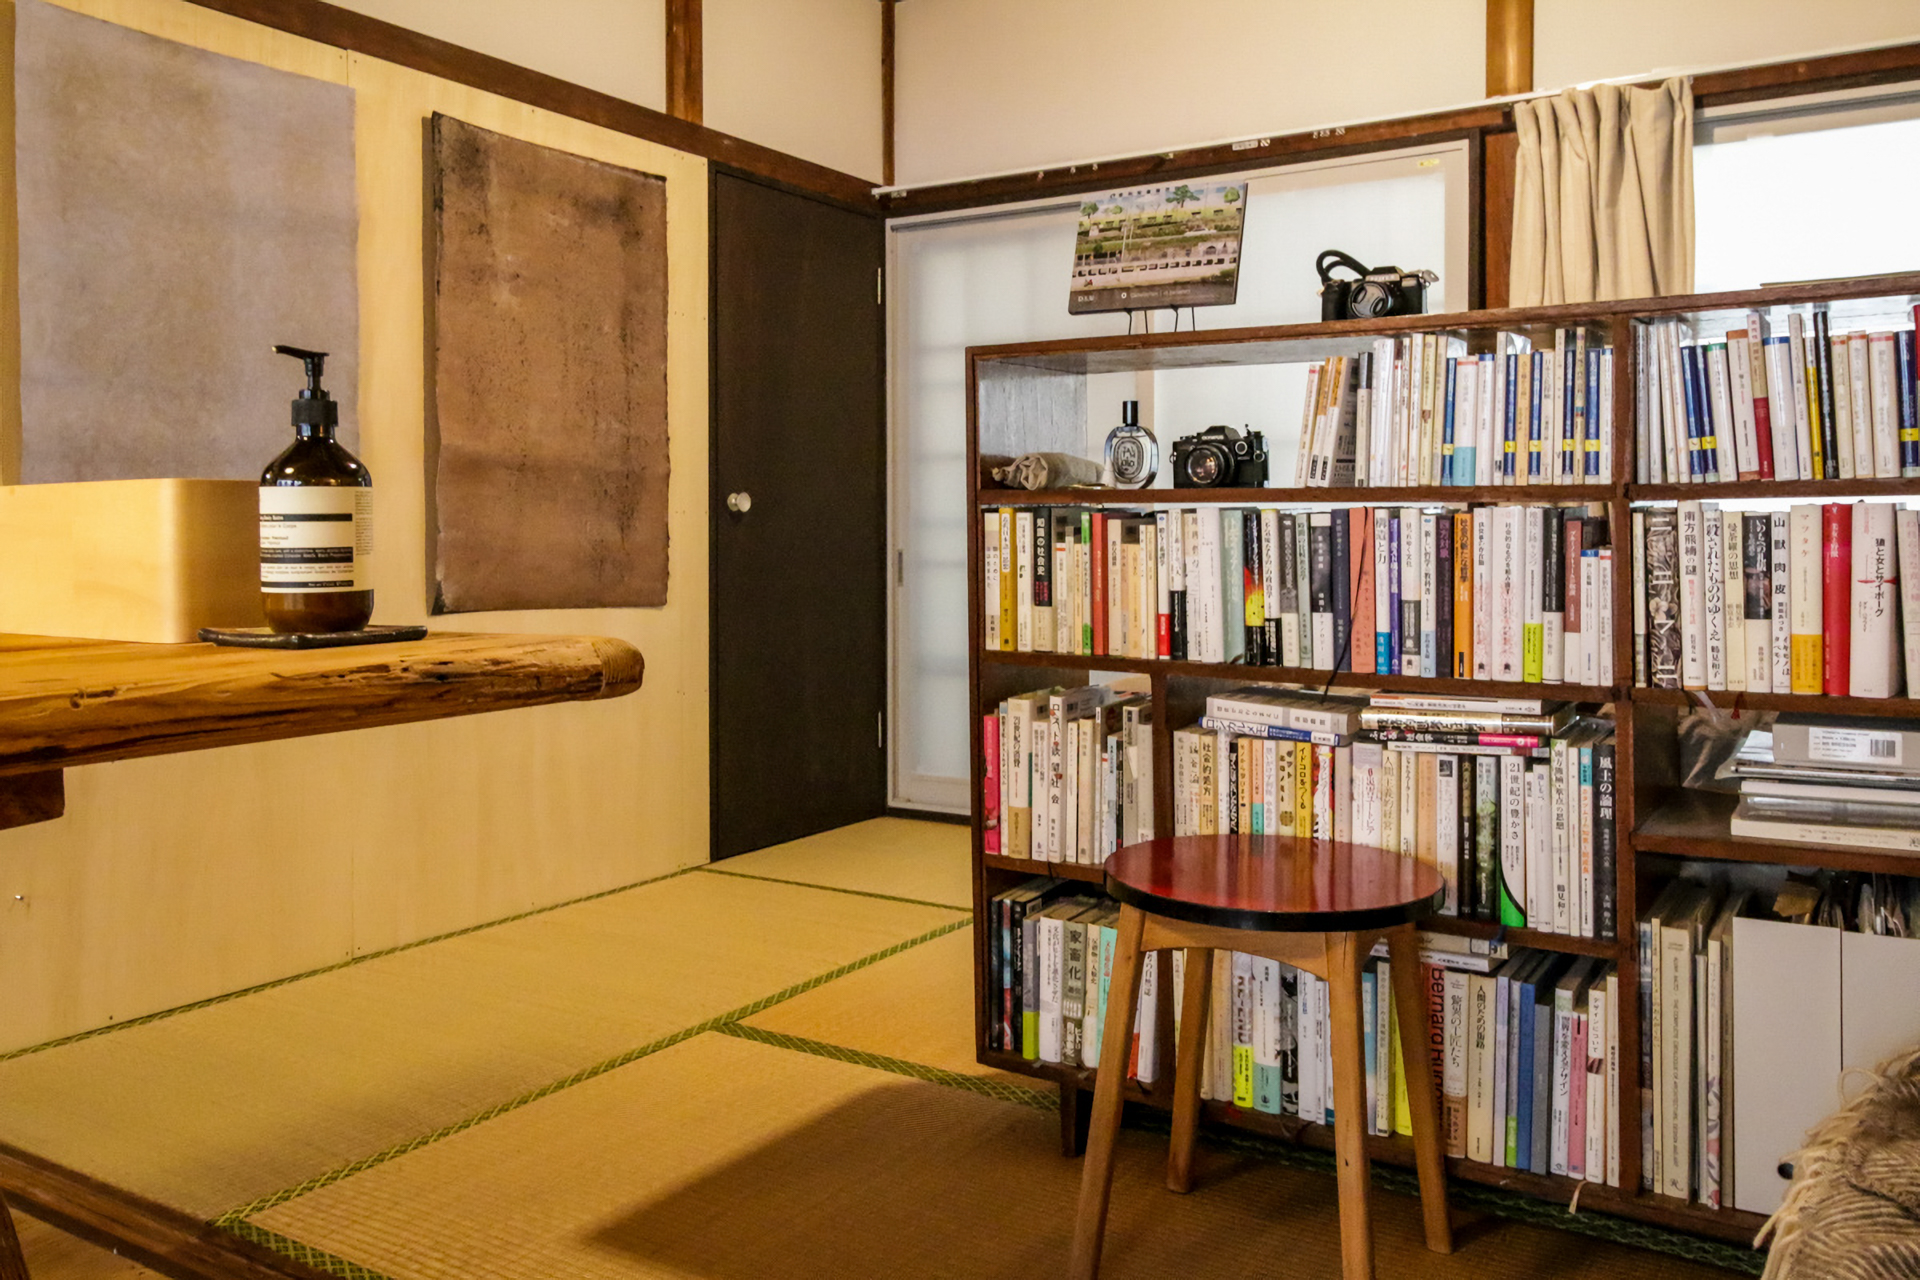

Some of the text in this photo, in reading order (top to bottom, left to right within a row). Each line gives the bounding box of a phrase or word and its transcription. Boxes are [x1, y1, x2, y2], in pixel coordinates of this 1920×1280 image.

[1375, 517, 1387, 564] 構造と力
[1460, 518, 1469, 583] 社会の新たな哲学
[1684, 511, 1697, 576] 南方熊楠の謎
[1727, 523, 1739, 580] 曼荼羅の思想
[1800, 514, 1809, 557] マツタケ
[1706, 523, 1721, 642] 殺されたもののゆくえ
[1875, 537, 1886, 617] 猿と女とサイボーグ
[1711, 645, 1720, 679] 鶴見和子
[1013, 716, 1021, 769] 21世紀の道徳
[1051, 703, 1061, 805] ロスト欲望社会
[1205, 718, 1268, 737] ロジカルメモ
[1203, 743, 1212, 796] 社会的処方
[1299, 747, 1307, 810] イドコロをつくる
[1599, 757, 1613, 820] 風土の論理
[1509, 762, 1520, 840] 21世紀の豊かさ
[1557, 884, 1565, 918] 鶴見和子
[1069, 929, 1082, 981] 家畜化
[1475, 985, 1486, 1050] 人間のための街路
